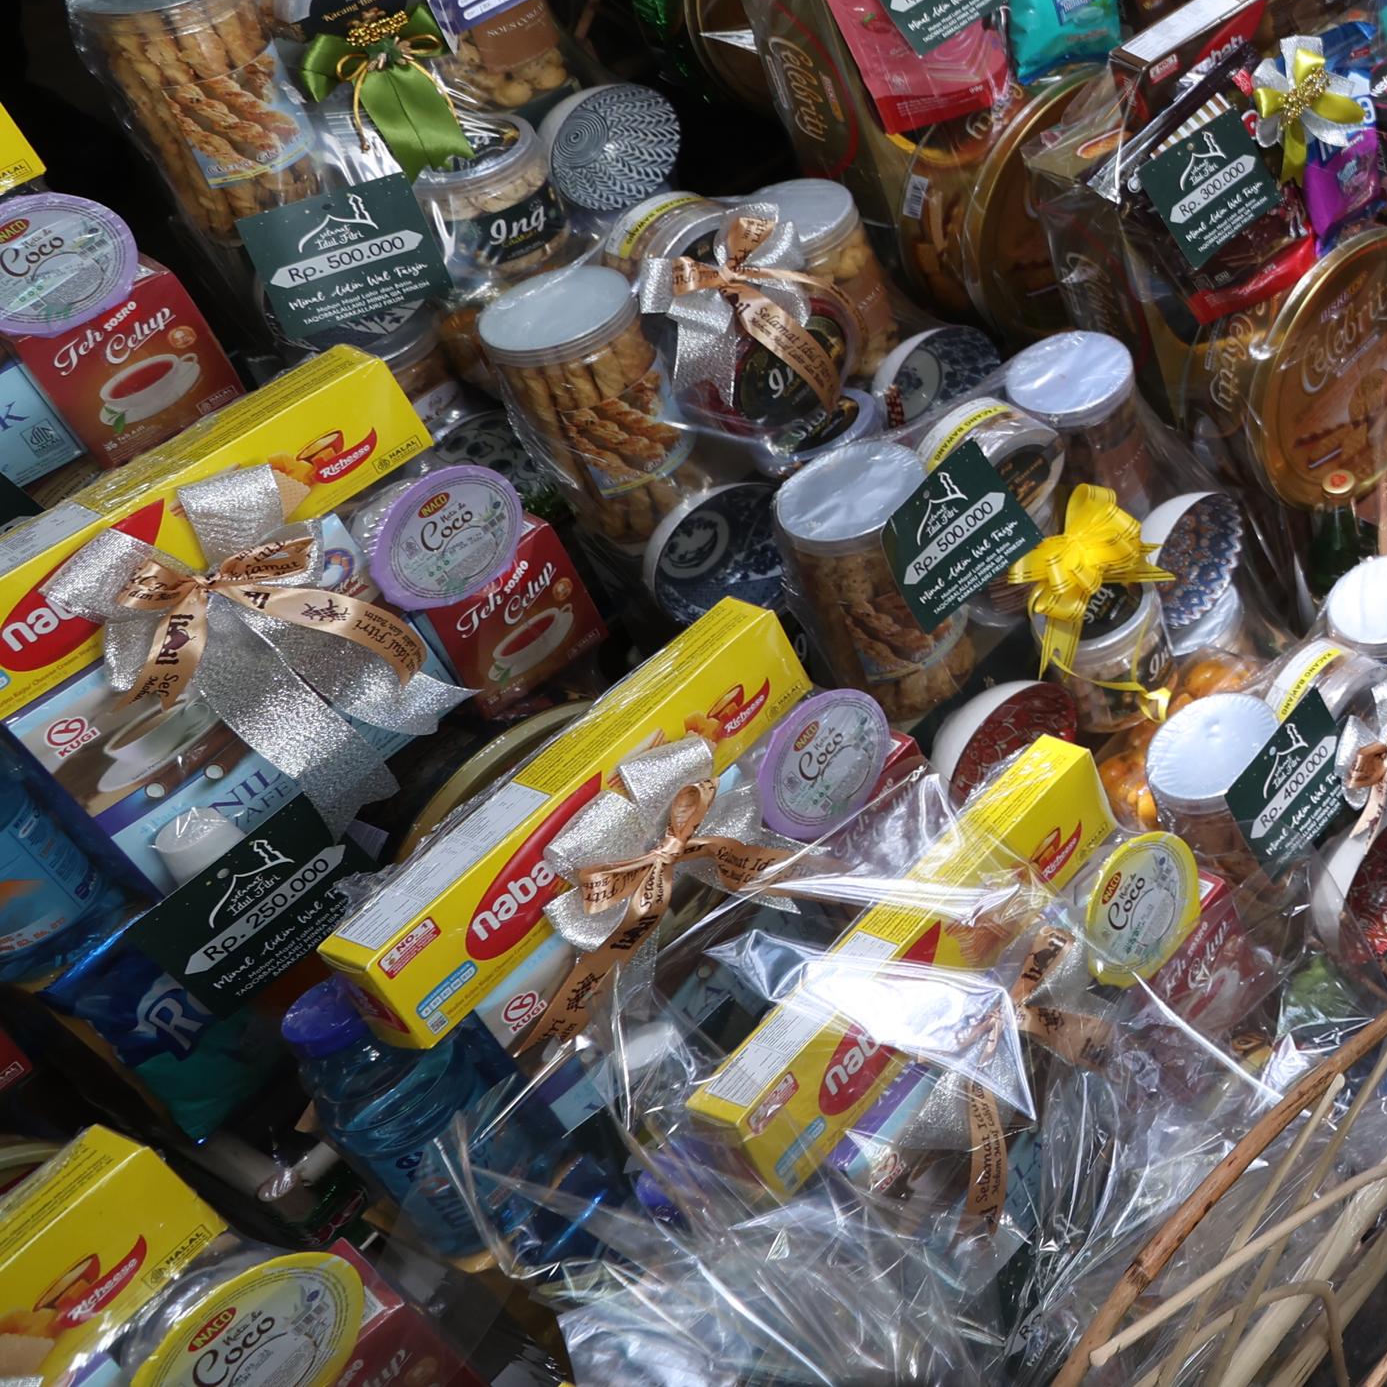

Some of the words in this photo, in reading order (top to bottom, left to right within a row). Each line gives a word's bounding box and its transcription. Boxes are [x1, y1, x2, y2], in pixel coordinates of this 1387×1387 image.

[1178, 201, 1201, 218] Rp.
[1200, 161, 1246, 201] 300.000
[0, 236, 64, 278] Coco
[288, 266, 324, 284] Rp.
[327, 236, 405, 271] 500.000
[103, 300, 138, 332] SOSRO
[288, 289, 327, 312] Minal
[54, 328, 105, 376] Teh
[104, 306, 171, 365] Celup
[319, 444, 371, 479] Richeese
[388, 439, 418, 459] HALAL
[420, 493, 449, 516] INACO
[420, 510, 473, 552] Coco
[913, 554, 938, 577] Rp.
[936, 500, 994, 553] 500.000
[503, 561, 557, 625] Celup
[504, 559, 529, 595] SOSRO
[456, 589, 504, 639] Teh
[57, 727, 100, 760] KUGI
[794, 722, 819, 751] INACO
[798, 731, 844, 781] Coco
[1259, 805, 1283, 830] Rp.
[1282, 743, 1329, 802] 400.000
[202, 933, 246, 962] Rp.
[246, 857, 330, 930] 250.000
[1102, 872, 1122, 905] INACO
[1107, 876, 1146, 932] Coco
[395, 931, 421, 952] NO.
[212, 955, 256, 991] Minal
[510, 999, 550, 1035] KUGI
[164, 1231, 205, 1265] HALAL
[68, 1257, 139, 1318] Richeese
[191, 1308, 237, 1350] INACO
[192, 1315, 276, 1387] Coco
